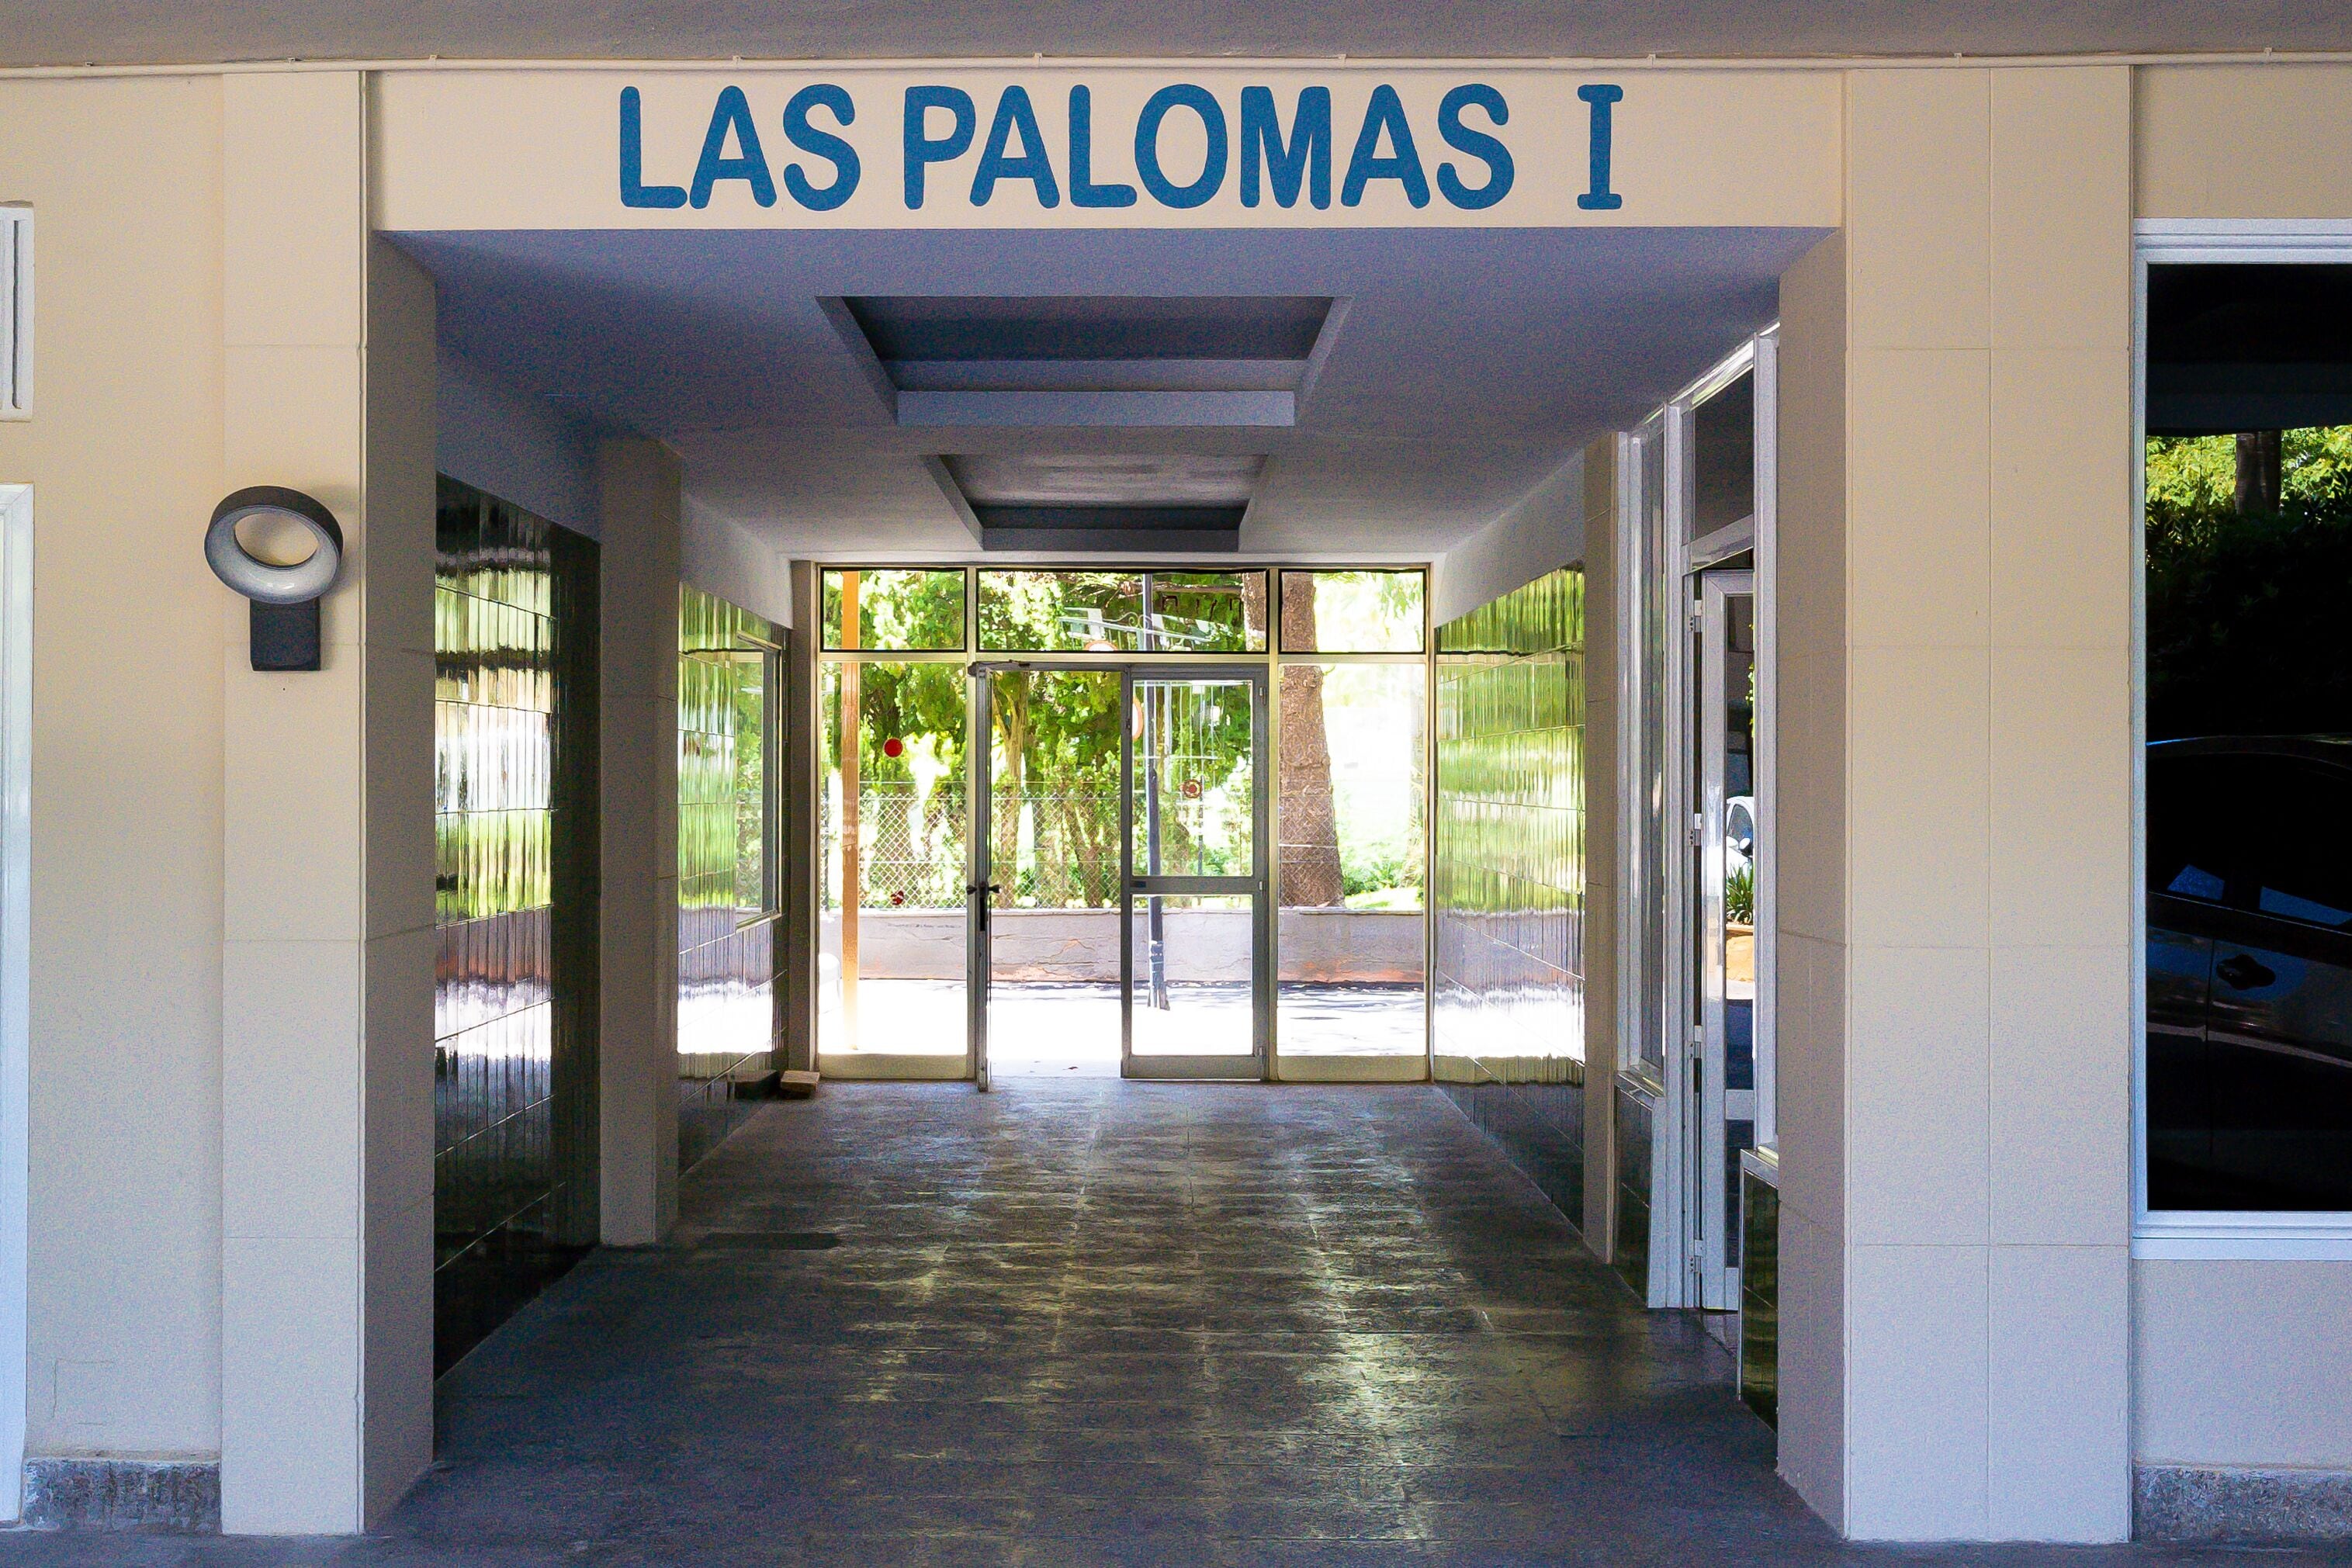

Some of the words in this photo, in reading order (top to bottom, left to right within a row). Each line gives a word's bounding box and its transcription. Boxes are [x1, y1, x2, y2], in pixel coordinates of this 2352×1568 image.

[620, 85, 860, 211] LAS
[904, 85, 1515, 210] PALOMAS
[1578, 85, 1623, 210] I
